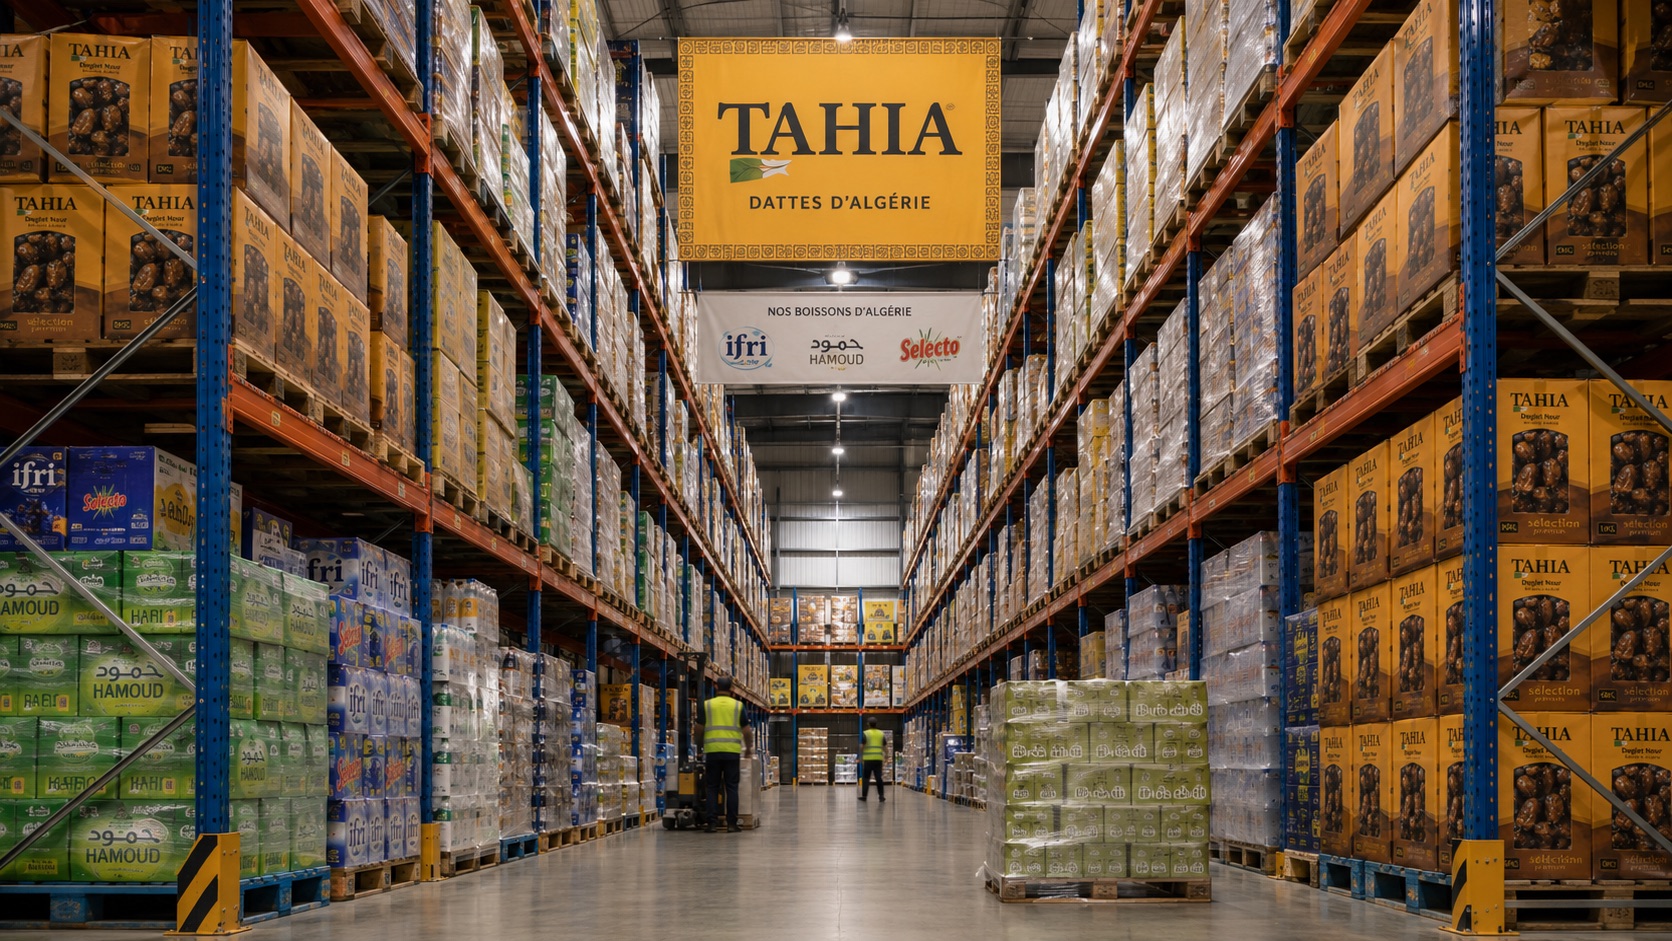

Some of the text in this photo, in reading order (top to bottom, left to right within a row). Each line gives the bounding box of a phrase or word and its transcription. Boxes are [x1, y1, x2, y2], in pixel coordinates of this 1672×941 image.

[68, 43, 131, 60] TAHIA
[717, 102, 963, 155] TAHIA
[1565, 120, 1626, 134] TAHIA
[14, 196, 77, 211] TAHIA
[132, 196, 195, 210] TAHIA
[749, 192, 931, 210] DATTES D'ALGÉRIE
[767, 304, 912, 317] NOS BOISSONS D'ALGÉRIE
[725, 333, 768, 360] ifri
[810, 338, 864, 353] حمود
[900, 336, 961, 363] Selecto
[809, 353, 864, 365] HAMOUD
[1510, 392, 1569, 408] TAHIA
[12, 460, 57, 490] ifri
[1511, 558, 1571, 574] TAHIA
[361, 560, 378, 590] ifri
[96, 664, 164, 682] حمود
[93, 683, 164, 699] HAMOUD
[349, 684, 366, 717] ifri
[1610, 727, 1671, 741] TAHIA
[88, 828, 161, 847] حمود
[349, 817, 366, 847] ifri
[86, 848, 161, 864] HAMOUD
